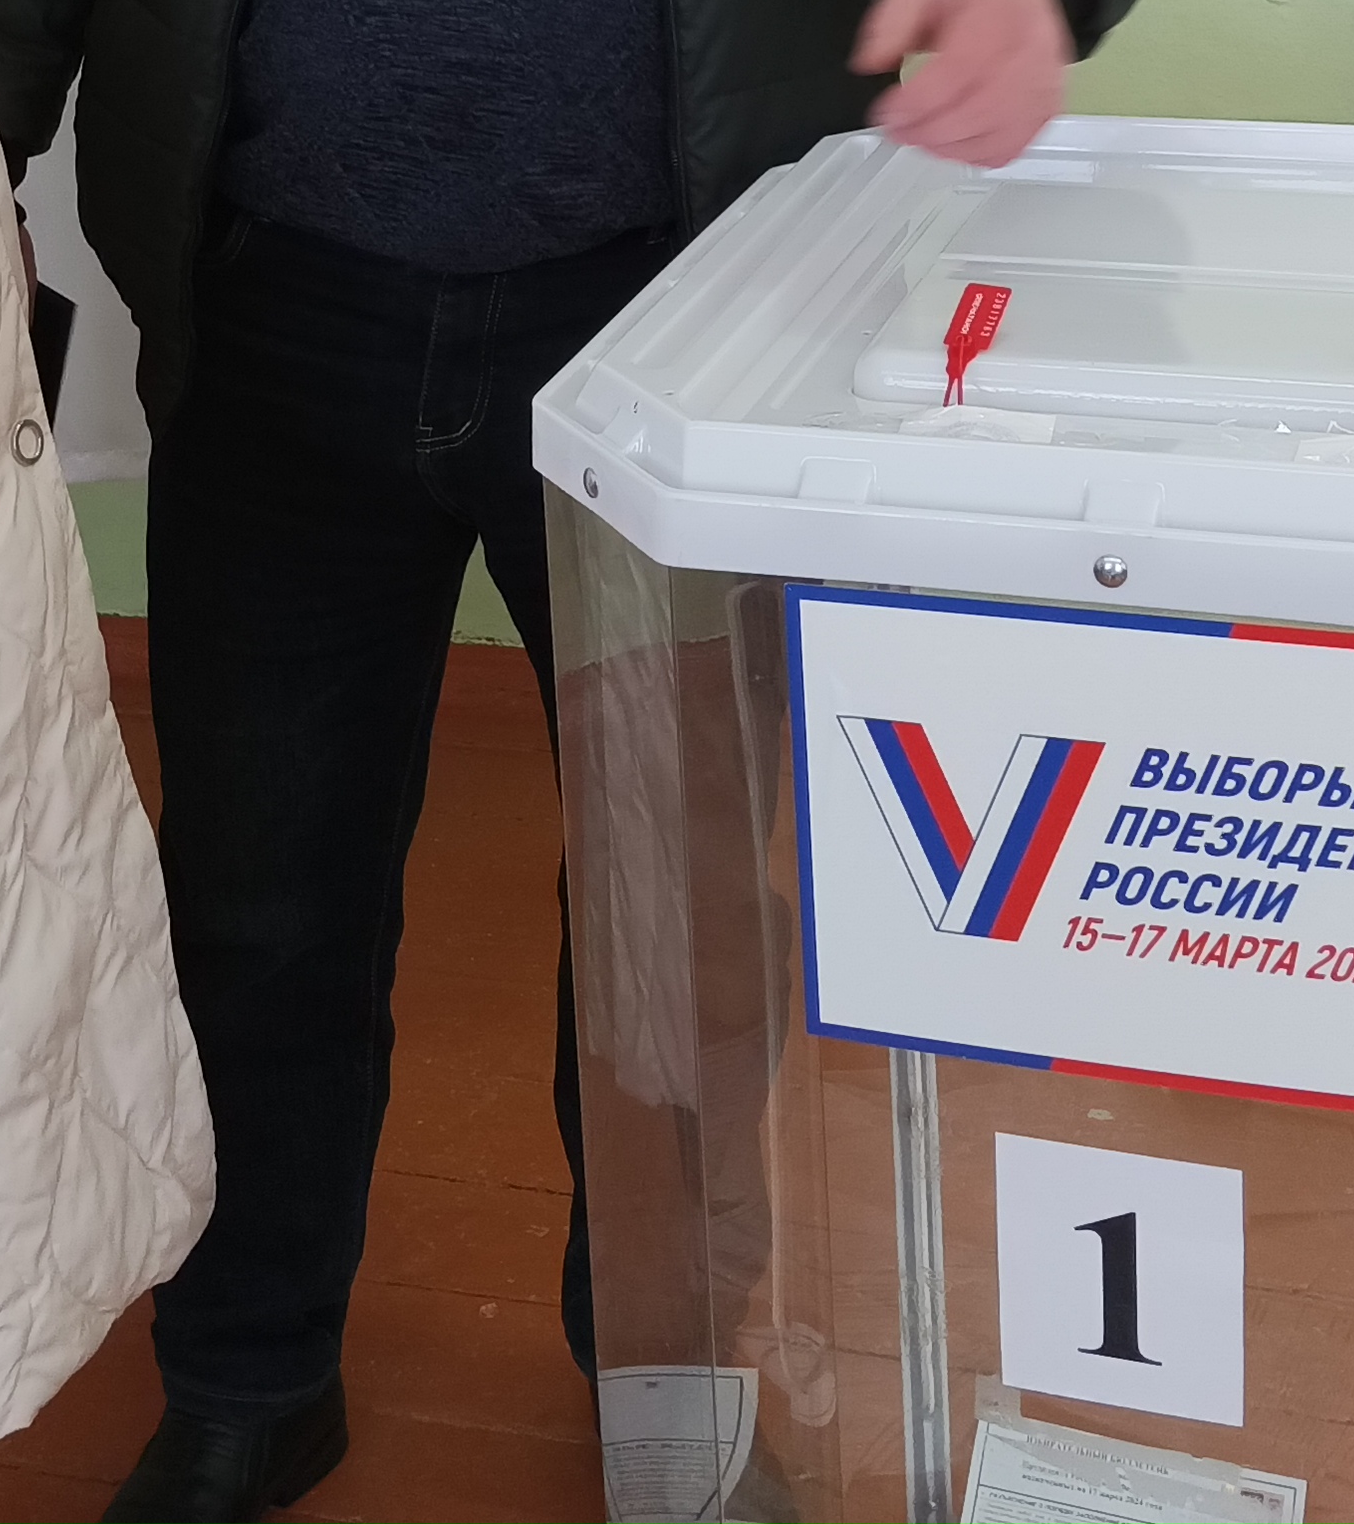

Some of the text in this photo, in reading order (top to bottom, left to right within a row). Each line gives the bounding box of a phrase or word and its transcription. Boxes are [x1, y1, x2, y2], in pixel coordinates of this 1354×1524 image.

[1079, 861, 1299, 923] РОССИИ
[1168, 928, 1300, 976] МАРТА
[1073, 1211, 1162, 1366] 1
